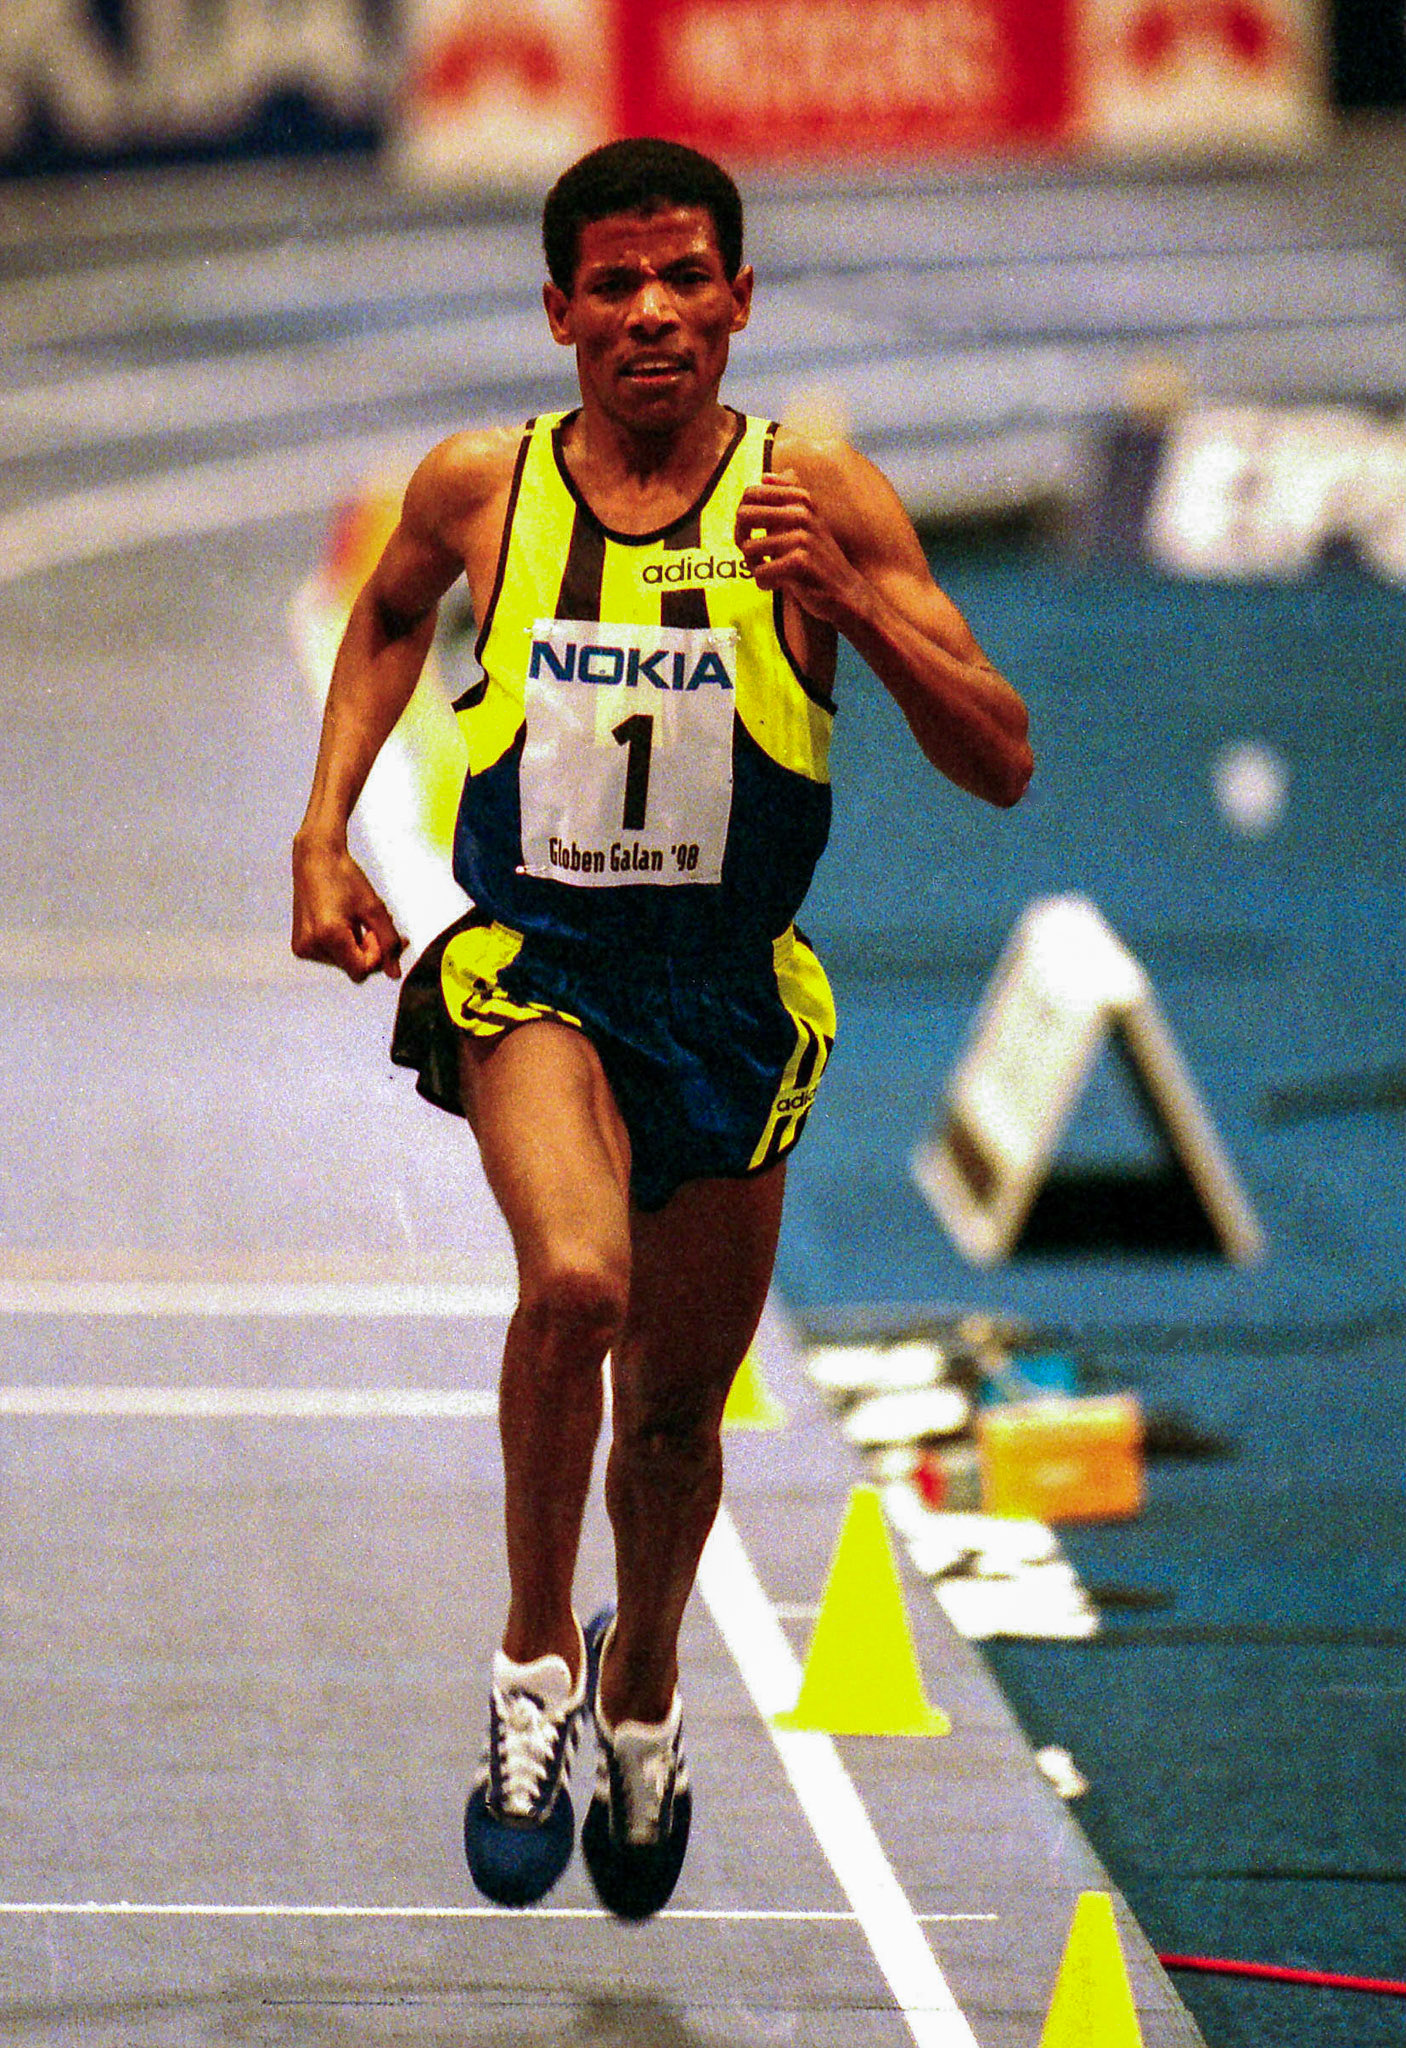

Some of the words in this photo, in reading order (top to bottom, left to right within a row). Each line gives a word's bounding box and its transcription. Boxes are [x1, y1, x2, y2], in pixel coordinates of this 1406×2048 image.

[642, 555, 754, 584] adidas
[528, 640, 734, 691] NOKIA
[611, 714, 654, 831] 1
[549, 837, 605, 873] Globen
[610, 842, 664, 872] Galan
[671, 843, 700, 871] '98
